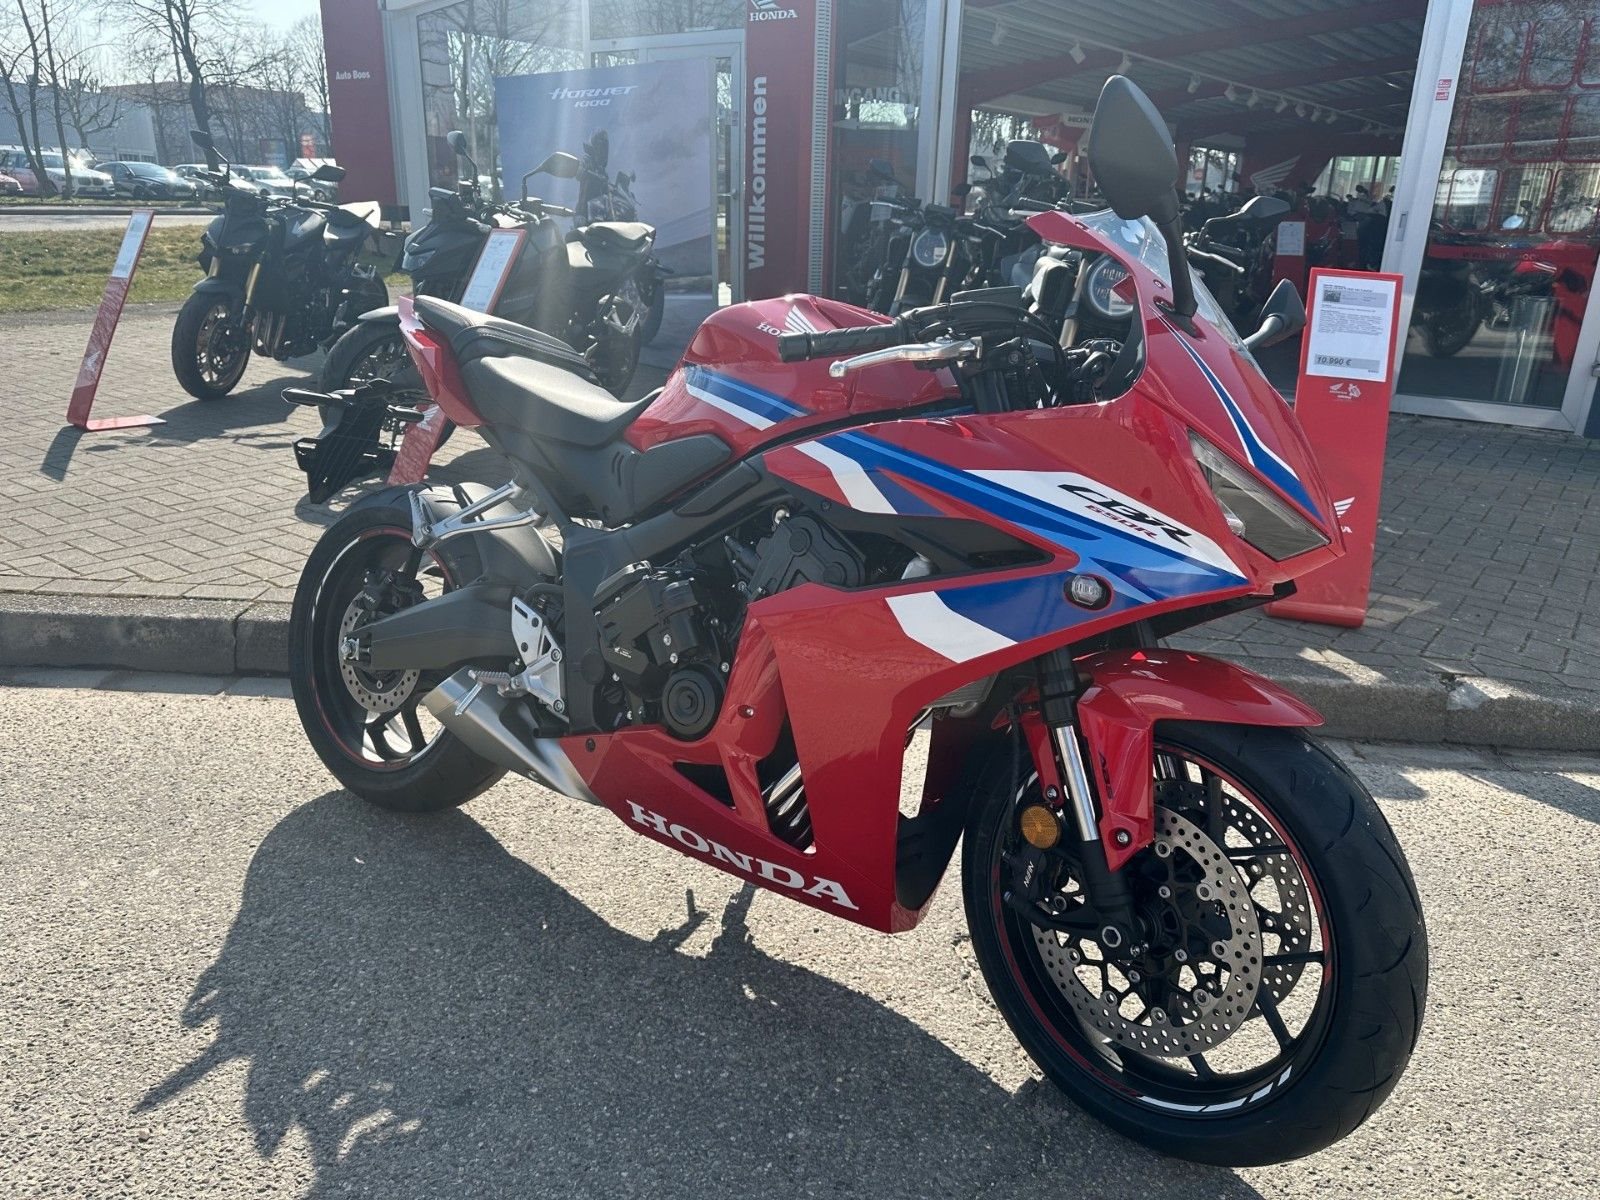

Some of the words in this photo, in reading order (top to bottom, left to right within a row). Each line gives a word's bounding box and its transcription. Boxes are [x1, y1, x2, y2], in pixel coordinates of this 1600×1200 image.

[749, 9, 798, 21] HONDA
[335, 71, 351, 80] Auto
[352, 70, 371, 79] Boos
[574, 99, 610, 108] 1000
[748, 76, 767, 270] Willkommen
[1317, 356, 1344, 366] 10.990
[1057, 485, 1192, 549] CBR
[1085, 504, 1159, 540] 650R
[626, 799, 860, 911] HONDA
